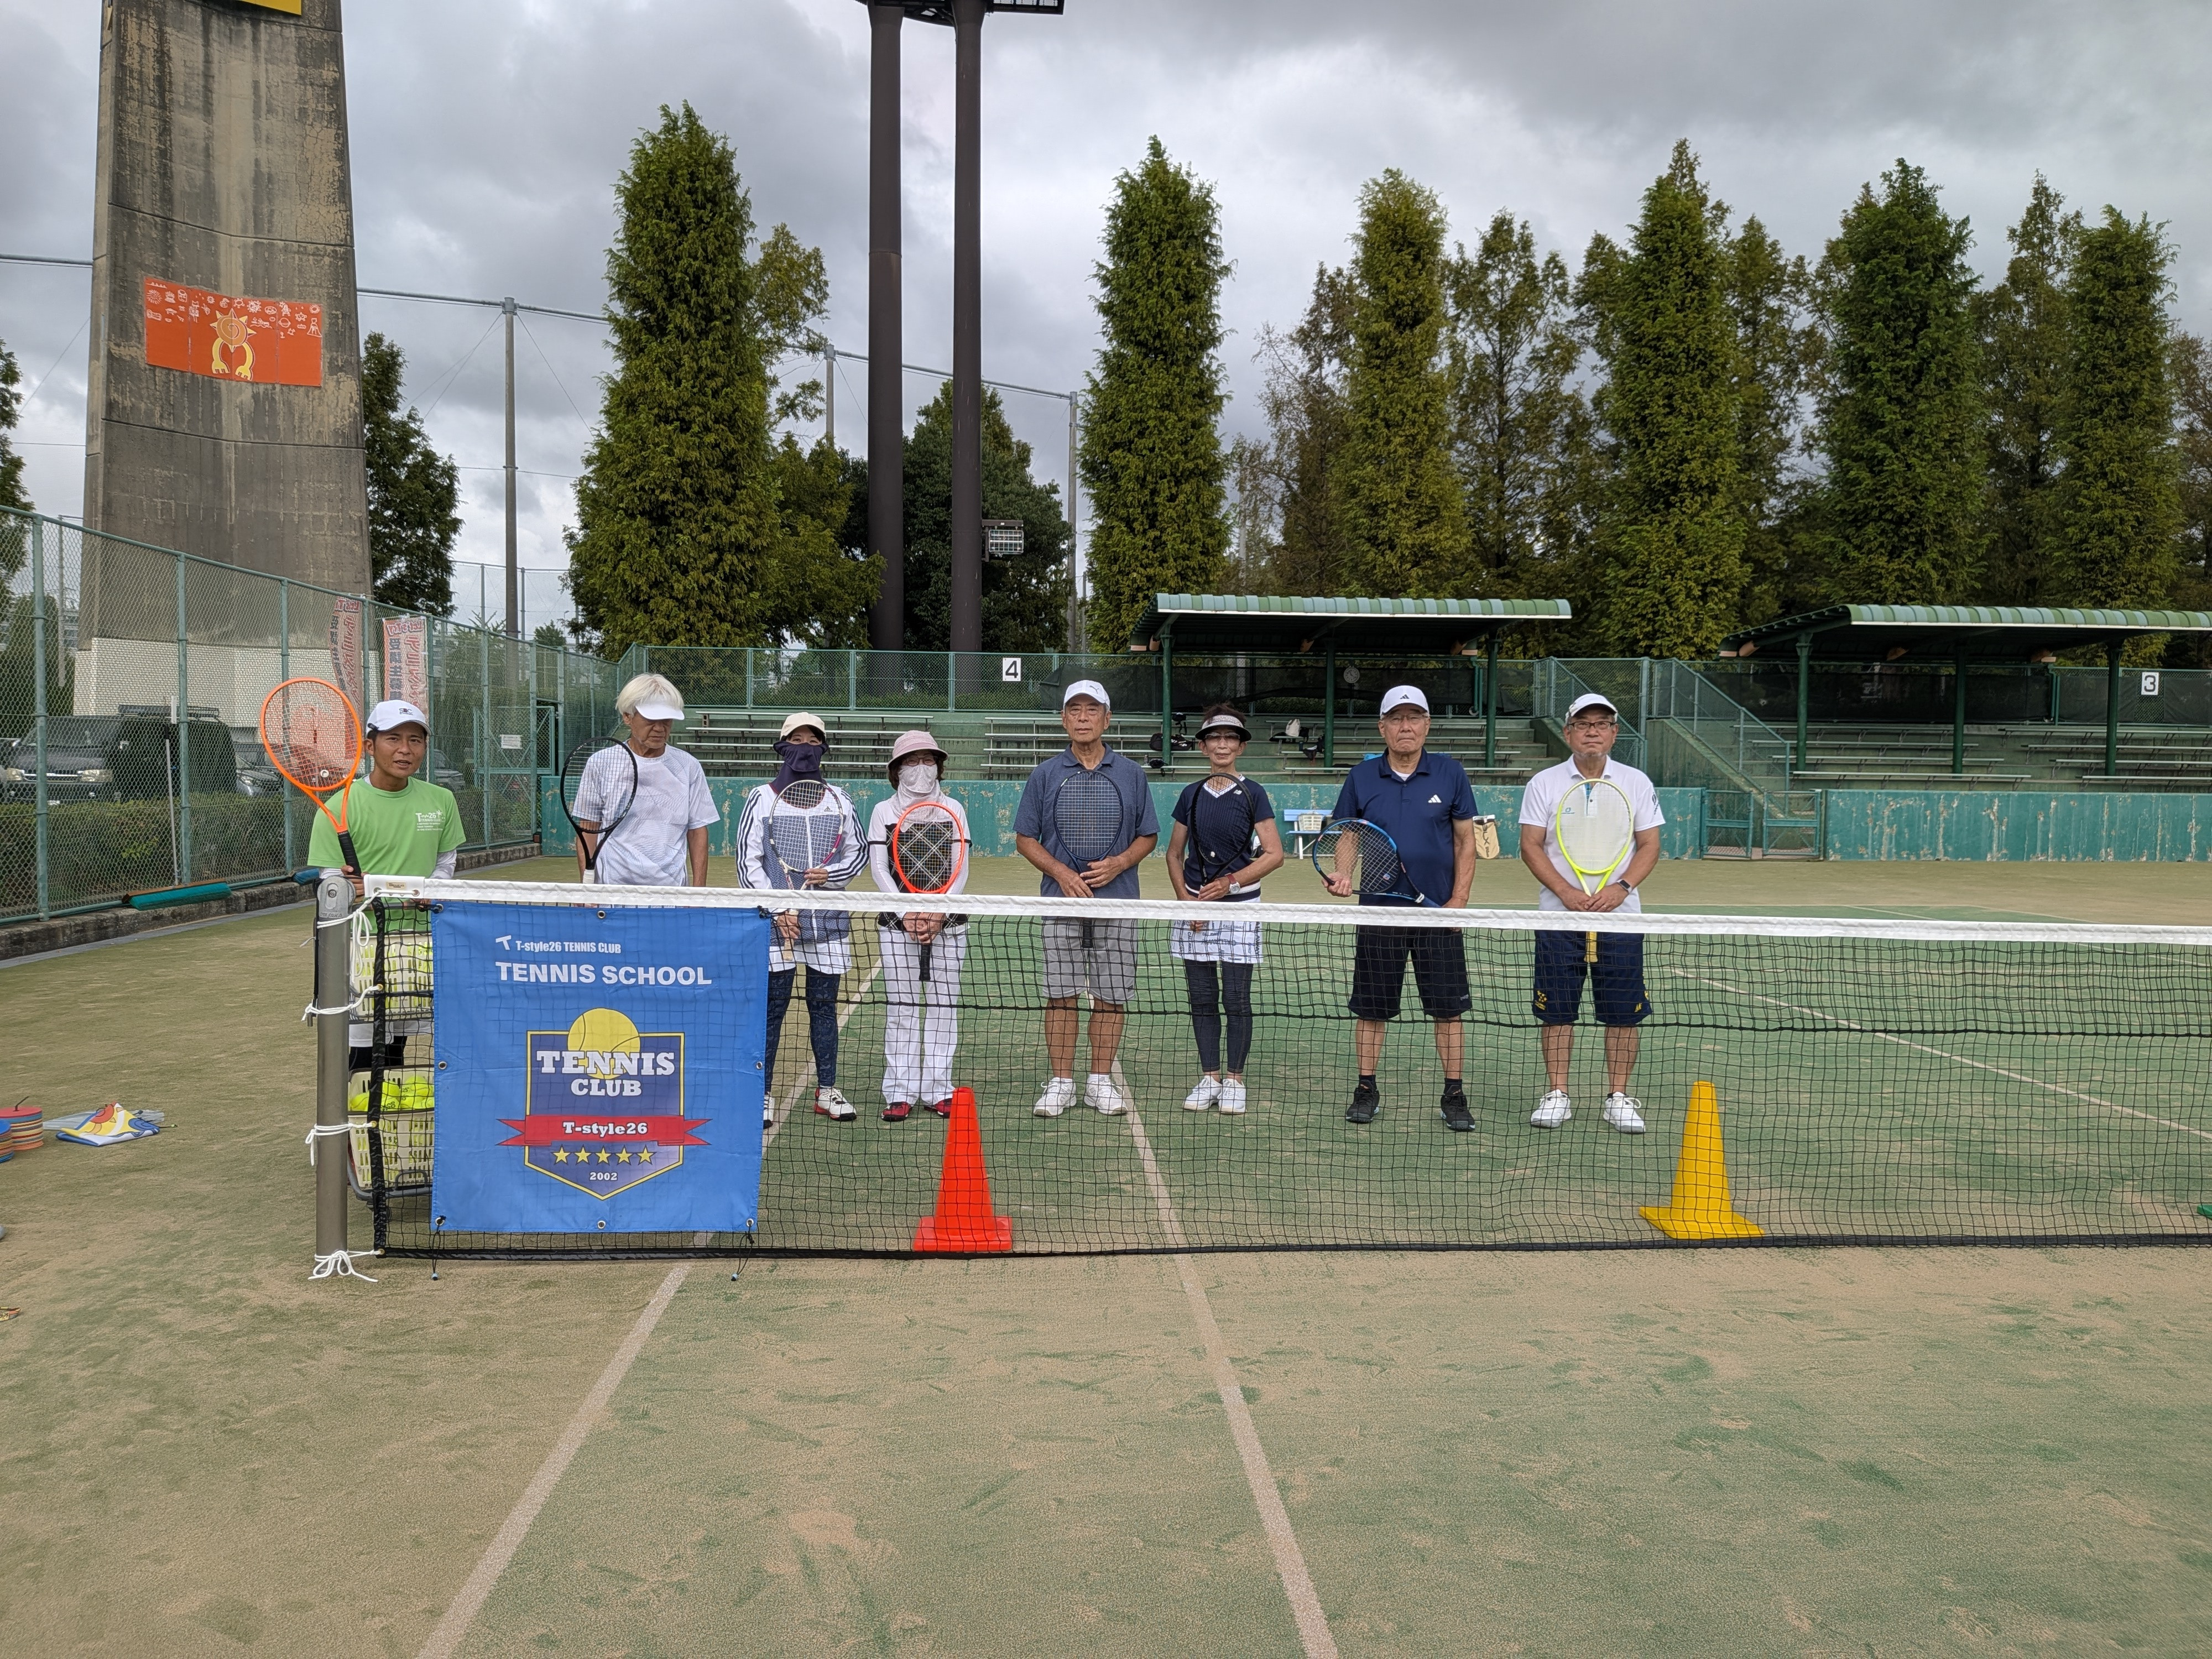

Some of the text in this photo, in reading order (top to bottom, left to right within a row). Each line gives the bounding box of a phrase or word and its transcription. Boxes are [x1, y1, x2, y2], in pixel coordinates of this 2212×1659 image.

[1005, 661, 1018, 679] 4
[2144, 675, 2156, 692] 3
[515, 941, 562, 953] T-style26
[564, 942, 596, 952] TENNIS
[598, 942, 621, 954] CLUB
[495, 961, 712, 985] TENNIS SCHOOL
[536, 1050, 675, 1076] TENNIS
[570, 1078, 642, 1097] CLUB
[562, 1121, 648, 1138] T-style26
[589, 1172, 618, 1181] 2002
